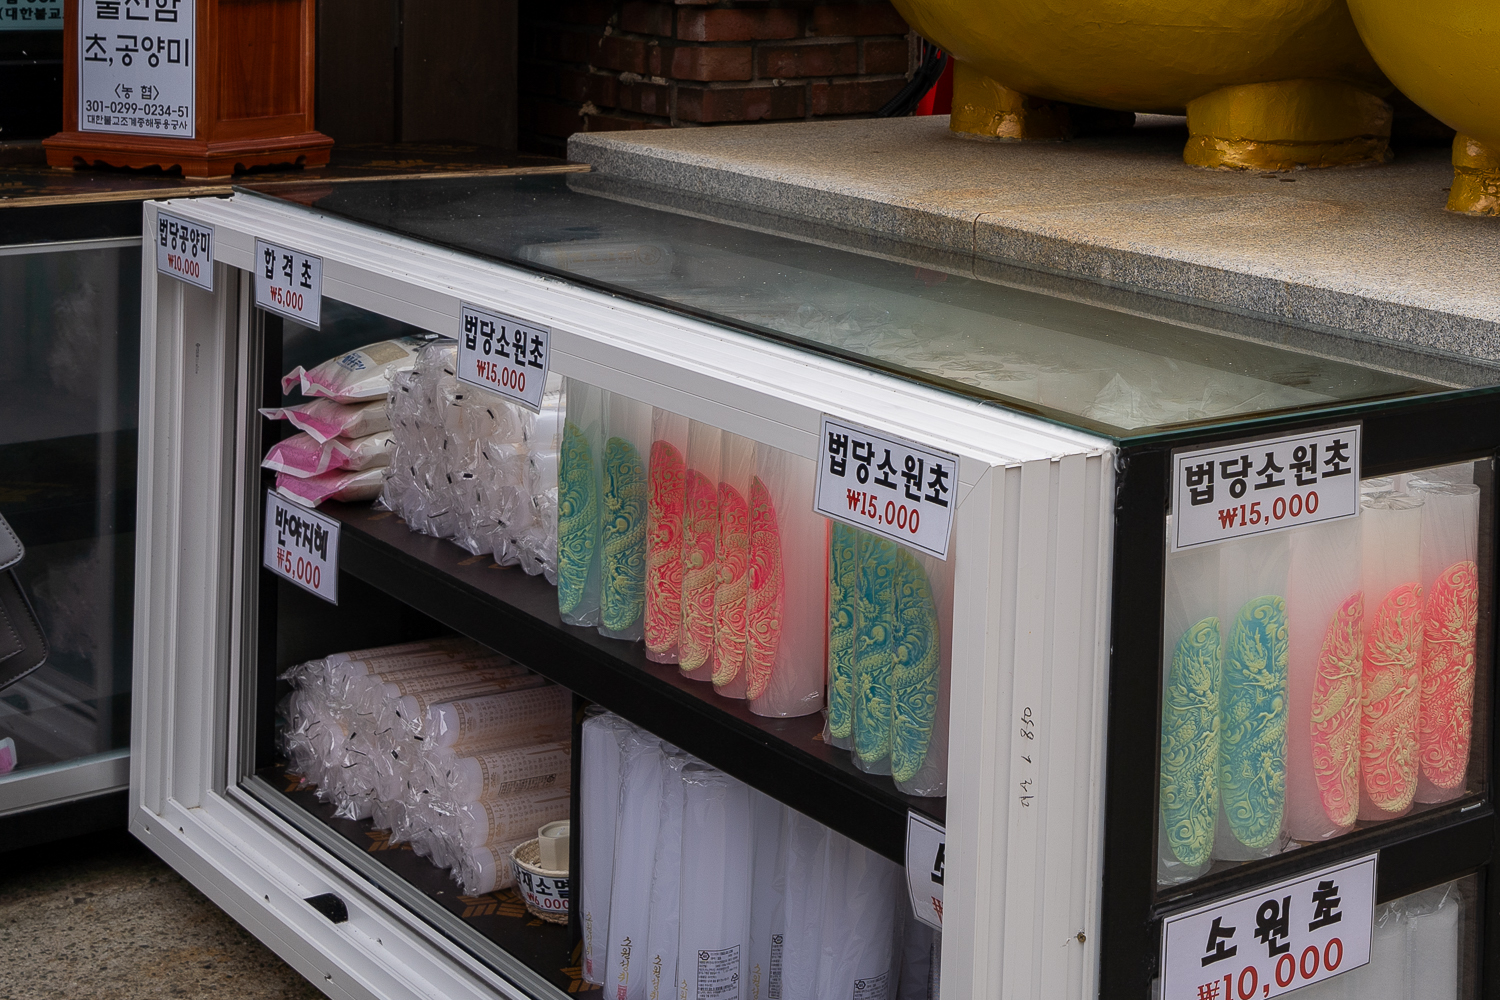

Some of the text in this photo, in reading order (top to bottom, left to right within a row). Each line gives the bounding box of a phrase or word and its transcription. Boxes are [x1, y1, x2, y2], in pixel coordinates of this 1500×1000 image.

[0, 7, 64, 20] (대한불교
[84, 33, 189, 68] 초,공양미
[85, 100, 189, 118] 301-0299-0234-51
[158, 217, 211, 263] 법당공양미
[167, 253, 200, 279] ₩10,000
[270, 285, 304, 312] ₩5,000
[464, 314, 544, 370] 법당소원초
[476, 359, 526, 393] ₩15,000
[828, 431, 949, 508] 법당소원초
[1184, 439, 1352, 506] 법당소원초
[846, 487, 920, 534] ₩15,000
[1218, 490, 1319, 530] ₩15,000
[275, 505, 329, 562] 반야지혜
[277, 546, 321, 589] ₩5,000
[1197, 937, 1343, 1000] ₩10,000
